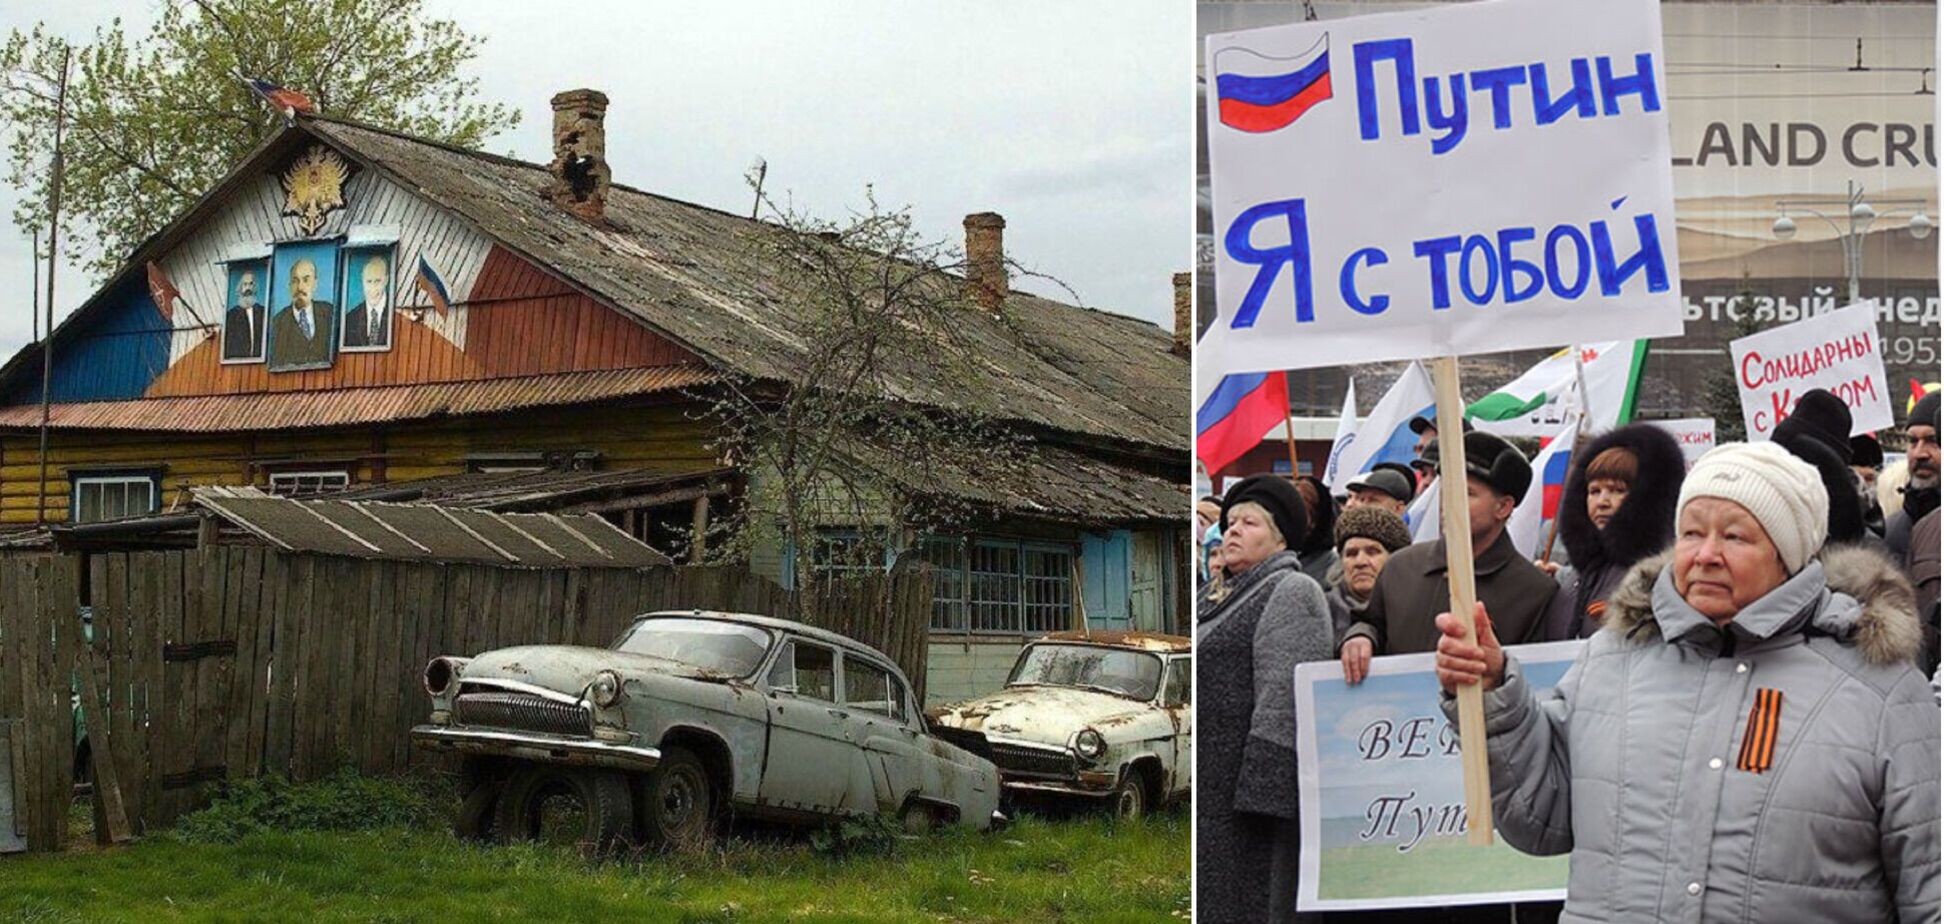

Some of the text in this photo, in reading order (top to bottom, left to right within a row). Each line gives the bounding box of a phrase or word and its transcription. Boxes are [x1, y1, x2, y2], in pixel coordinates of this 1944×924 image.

[1352, 37, 1662, 155] Путин
[1224, 197, 1315, 329] Я
[1879, 336, 1941, 364] 195
